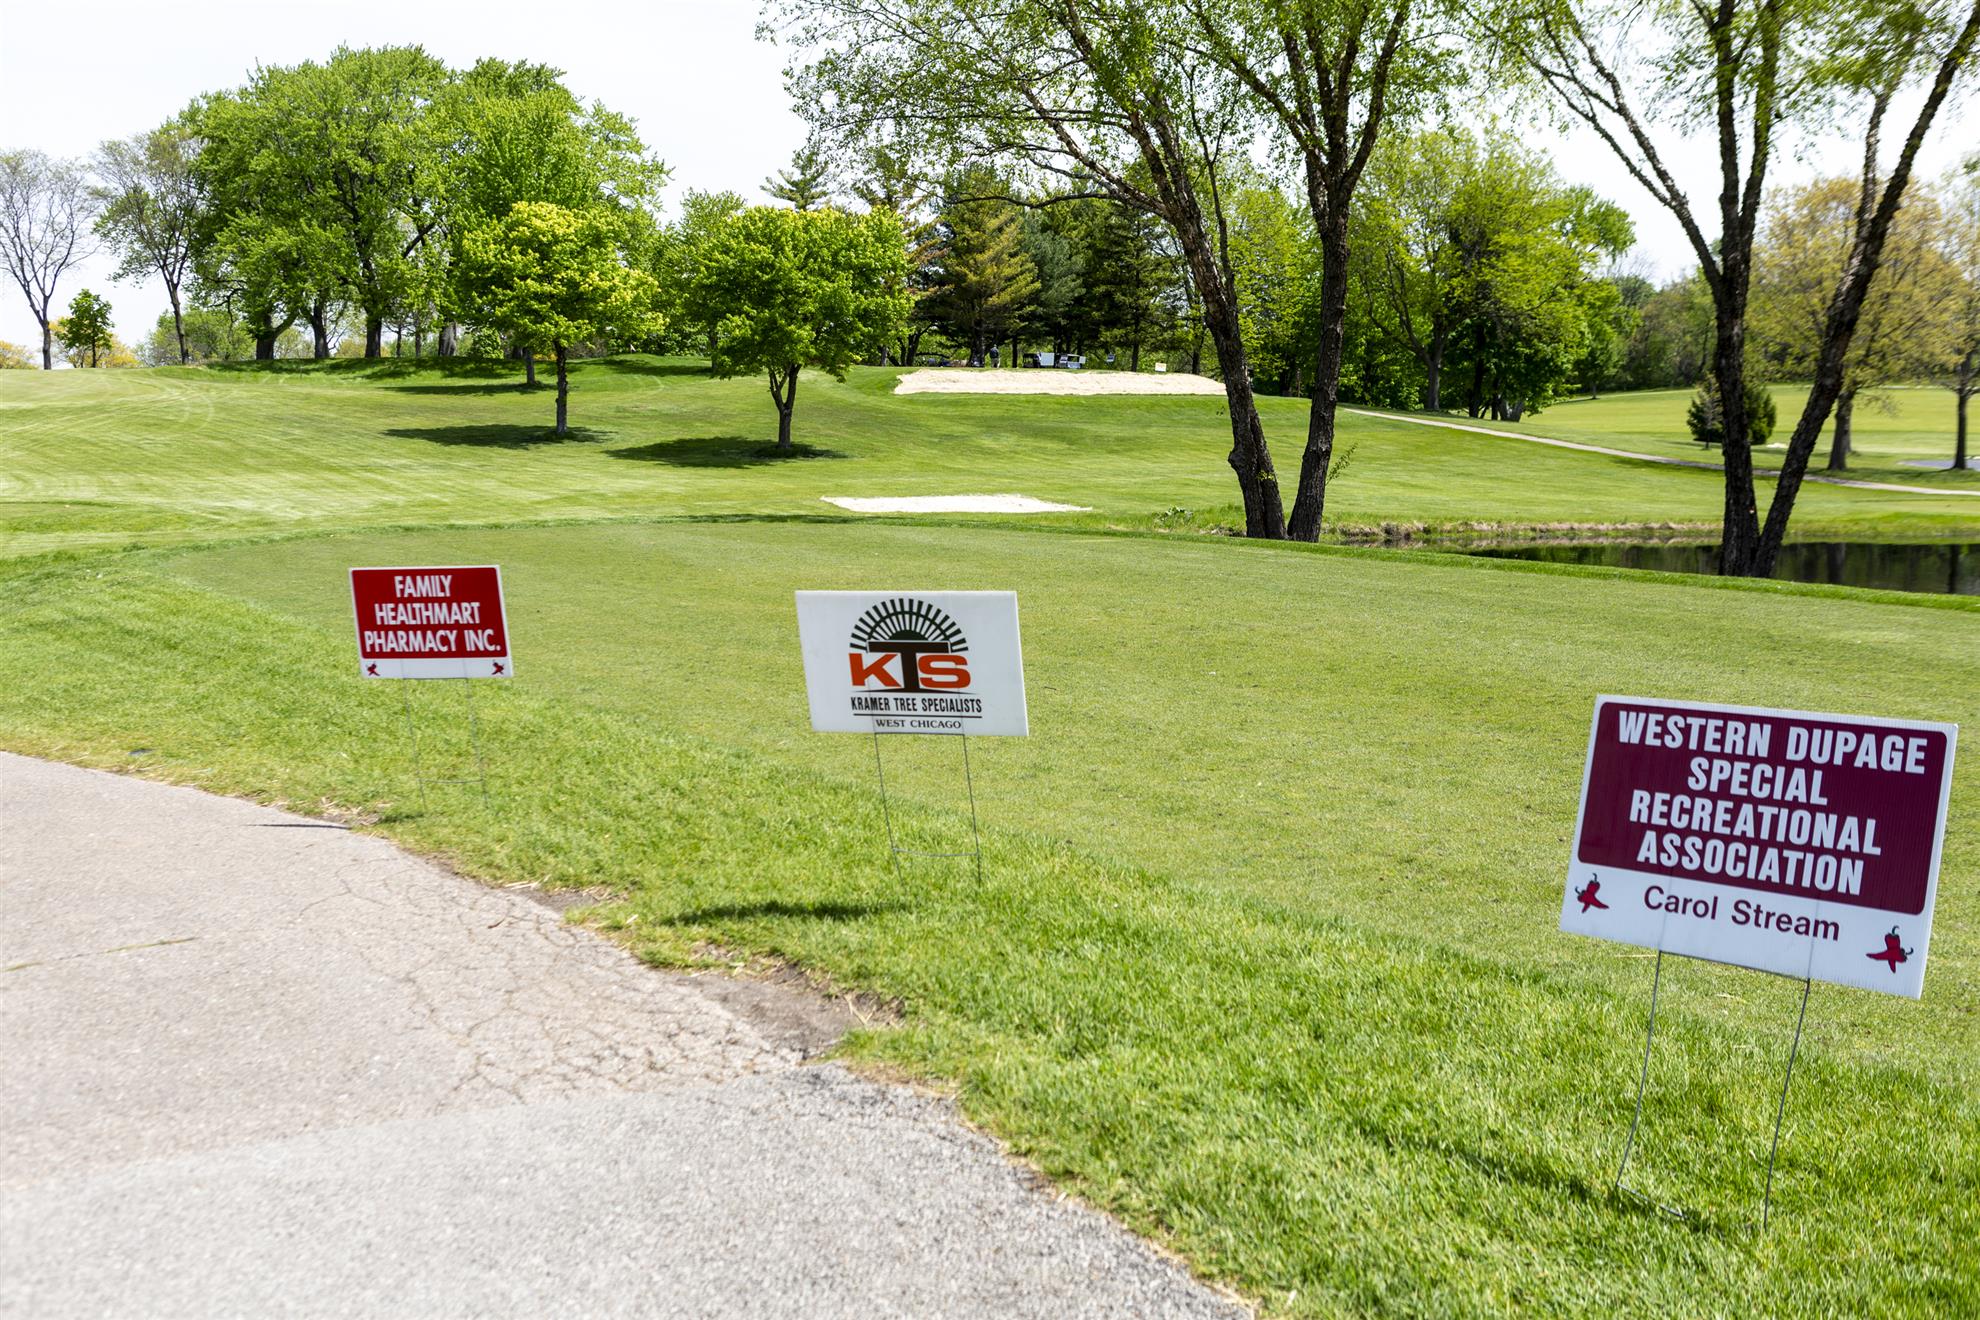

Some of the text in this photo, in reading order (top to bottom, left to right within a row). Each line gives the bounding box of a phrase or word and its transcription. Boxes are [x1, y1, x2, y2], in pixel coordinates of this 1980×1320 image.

[394, 575, 452, 598] FAMILY
[374, 602, 480, 625] HEALTHMART
[364, 628, 502, 653] PHARMACY INC.
[848, 641, 974, 693] KTS
[850, 696, 982, 714] KRAMER TREE SPECIALISTS
[875, 719, 962, 729] WEST CHICAGO
[1618, 710, 1928, 775] WESTERN DUPAGE
[1687, 756, 1828, 806] SPECIAL
[1629, 789, 1882, 856] RECREATIONAL
[1636, 829, 1865, 896] ASSOCIATION
[1643, 885, 1841, 942] Carol Stream
